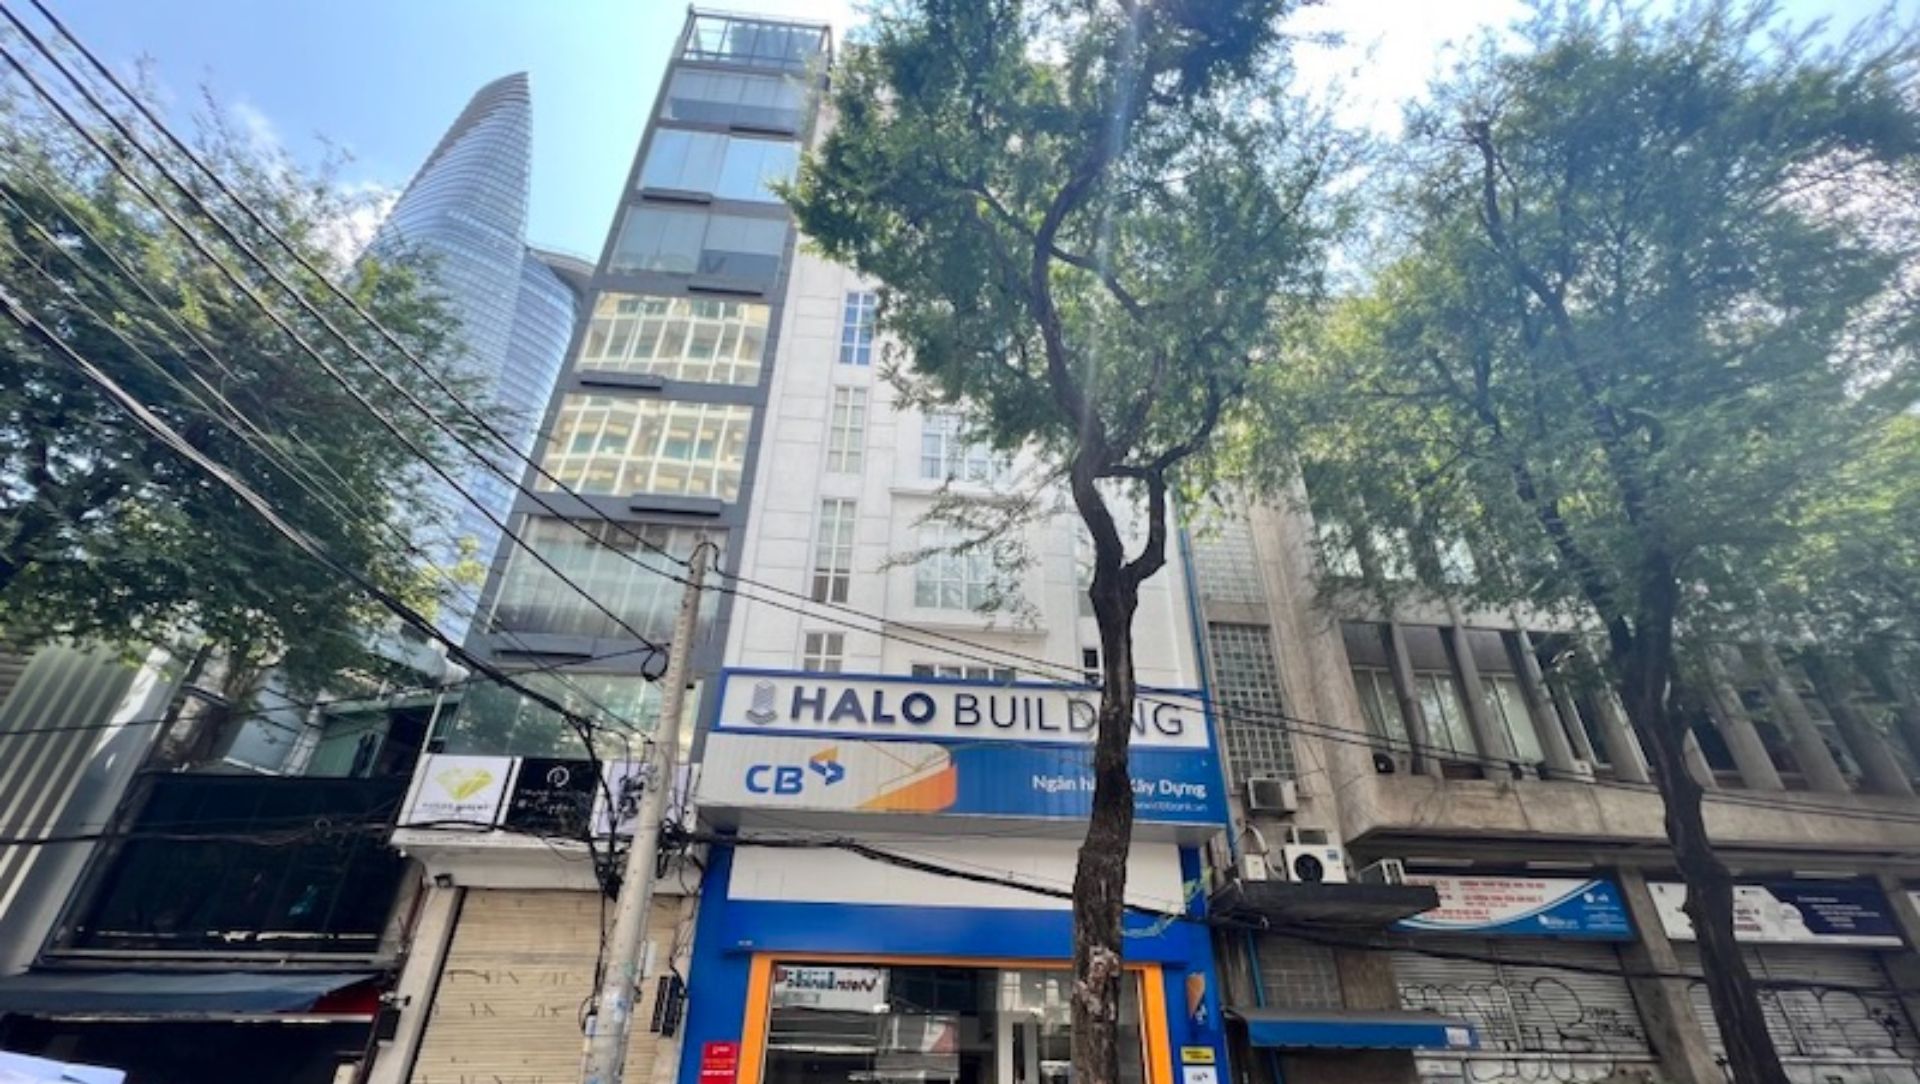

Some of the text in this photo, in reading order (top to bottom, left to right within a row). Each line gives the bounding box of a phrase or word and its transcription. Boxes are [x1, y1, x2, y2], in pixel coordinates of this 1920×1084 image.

[790, 685, 1184, 736] HALO BUILDNG
[746, 764, 804, 795] CB
